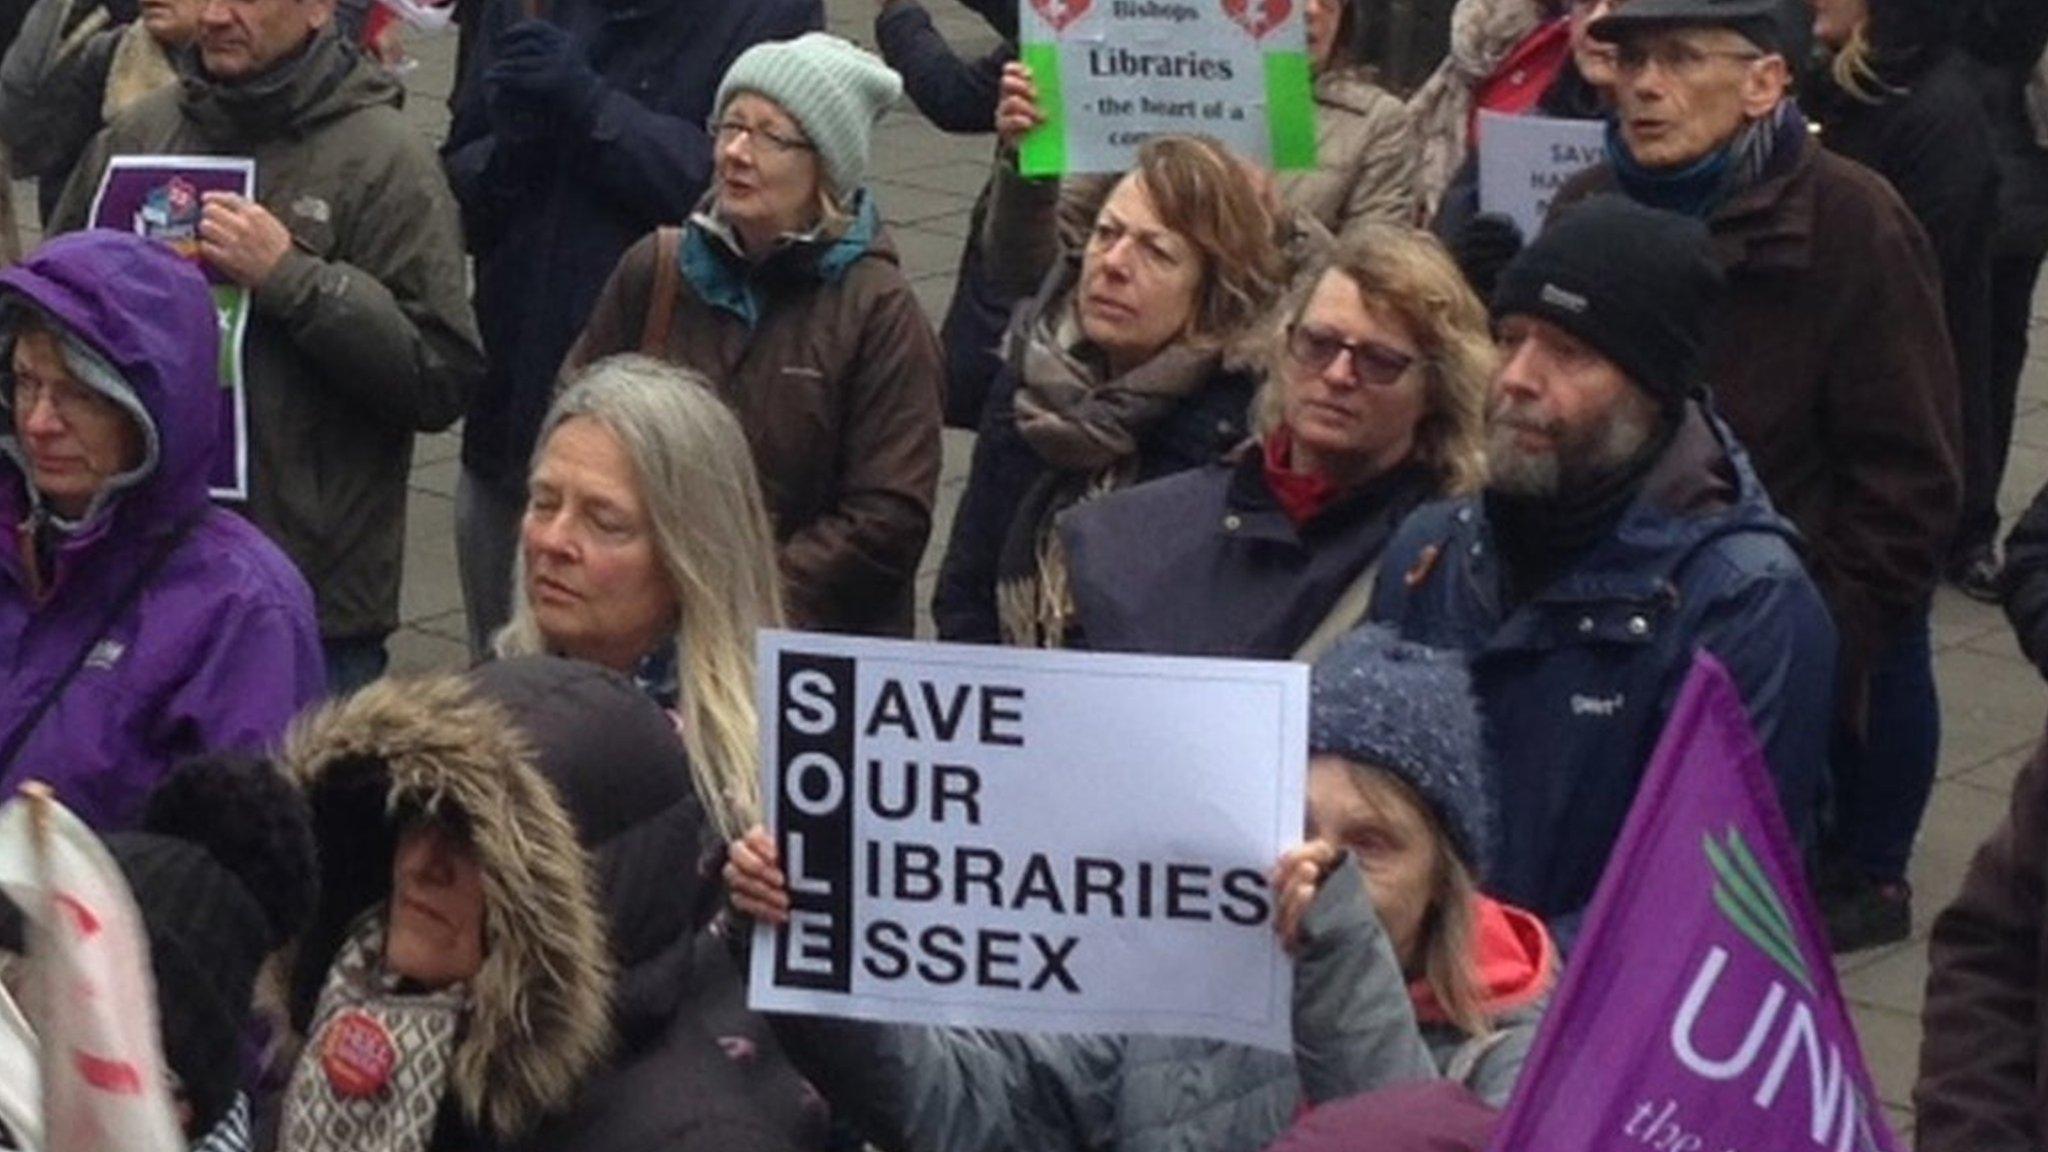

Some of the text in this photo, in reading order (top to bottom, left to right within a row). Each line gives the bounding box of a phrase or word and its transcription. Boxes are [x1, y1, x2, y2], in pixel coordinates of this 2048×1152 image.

[1090, 49, 1232, 80] Libraries
[1098, 96, 1133, 116] the
[1140, 97, 1195, 118] heart
[1203, 102, 1223, 119] of
[1231, 107, 1244, 121] a
[785, 670, 1025, 747] SAVE
[786, 751, 982, 825] OUR
[787, 832, 1270, 927] LIBRARIES
[786, 909, 1082, 994] ESSEX
